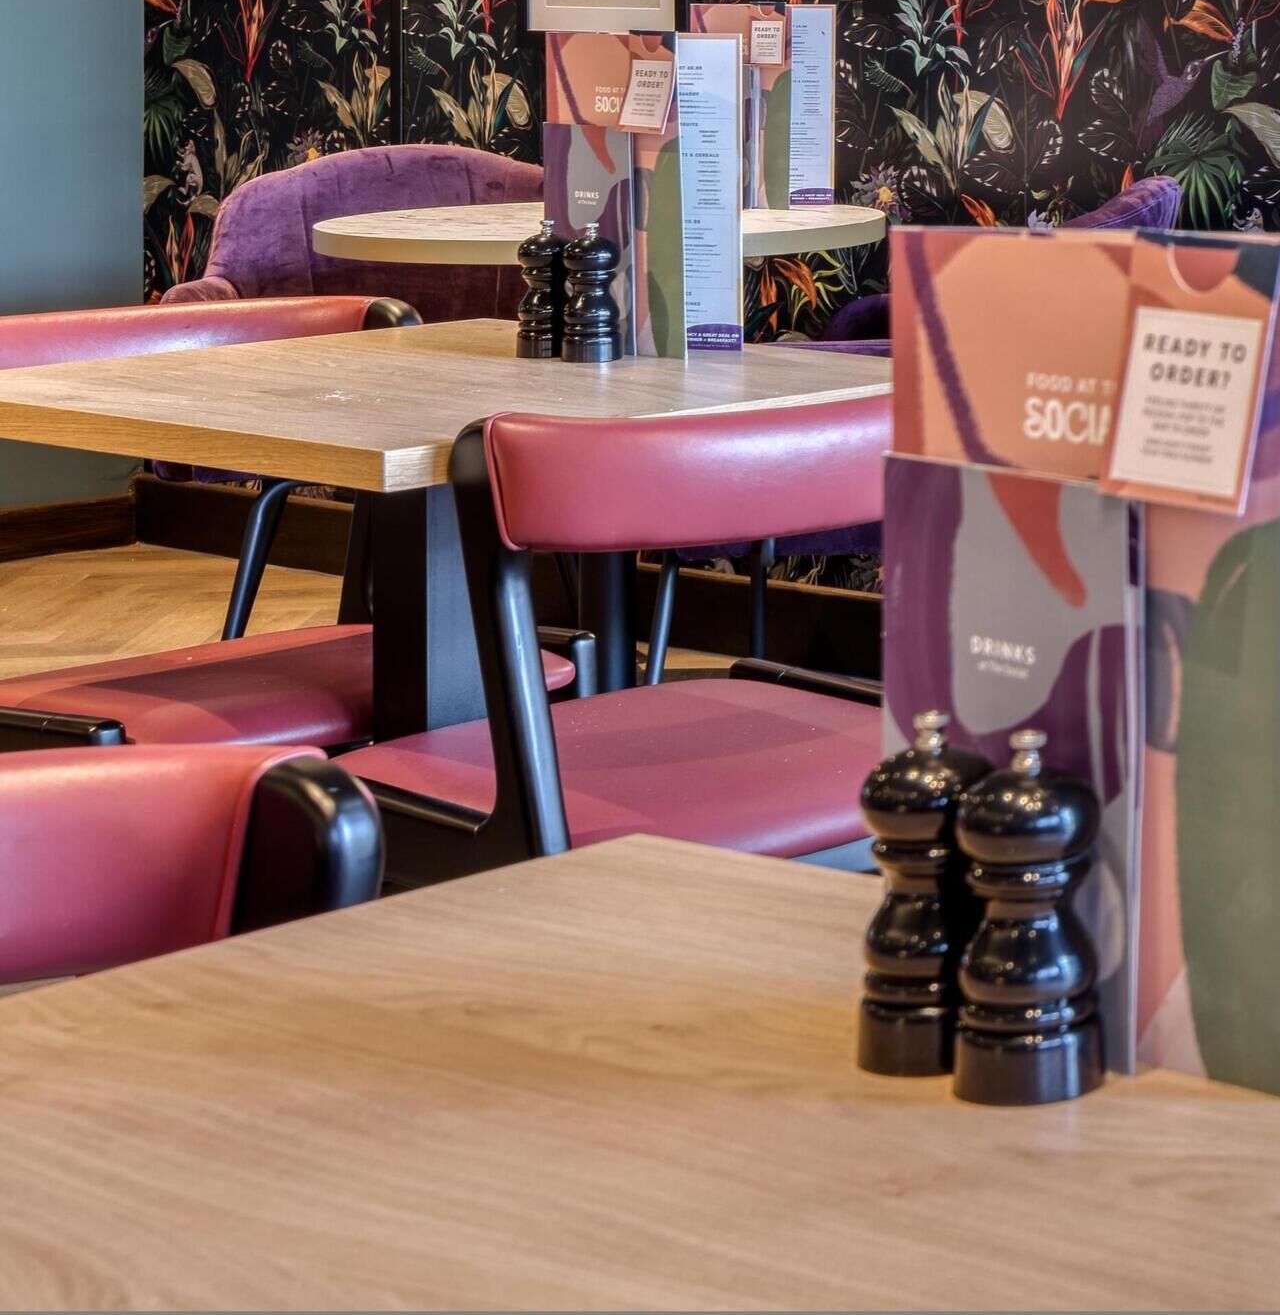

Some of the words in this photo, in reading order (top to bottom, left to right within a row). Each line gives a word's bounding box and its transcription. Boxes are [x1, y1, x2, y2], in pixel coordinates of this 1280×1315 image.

[635, 70, 658, 78] READY
[659, 71, 669, 79] TO
[637, 80, 665, 89] ORDER?
[574, 190, 600, 199] DRINKS
[1142, 333, 1212, 359] READY
[1218, 342, 1249, 365] TO
[1024, 371, 1073, 394] FOOD
[1075, 377, 1097, 395] AT
[1148, 362, 1233, 391] ORDER?
[969, 634, 1037, 666] DRINKS
